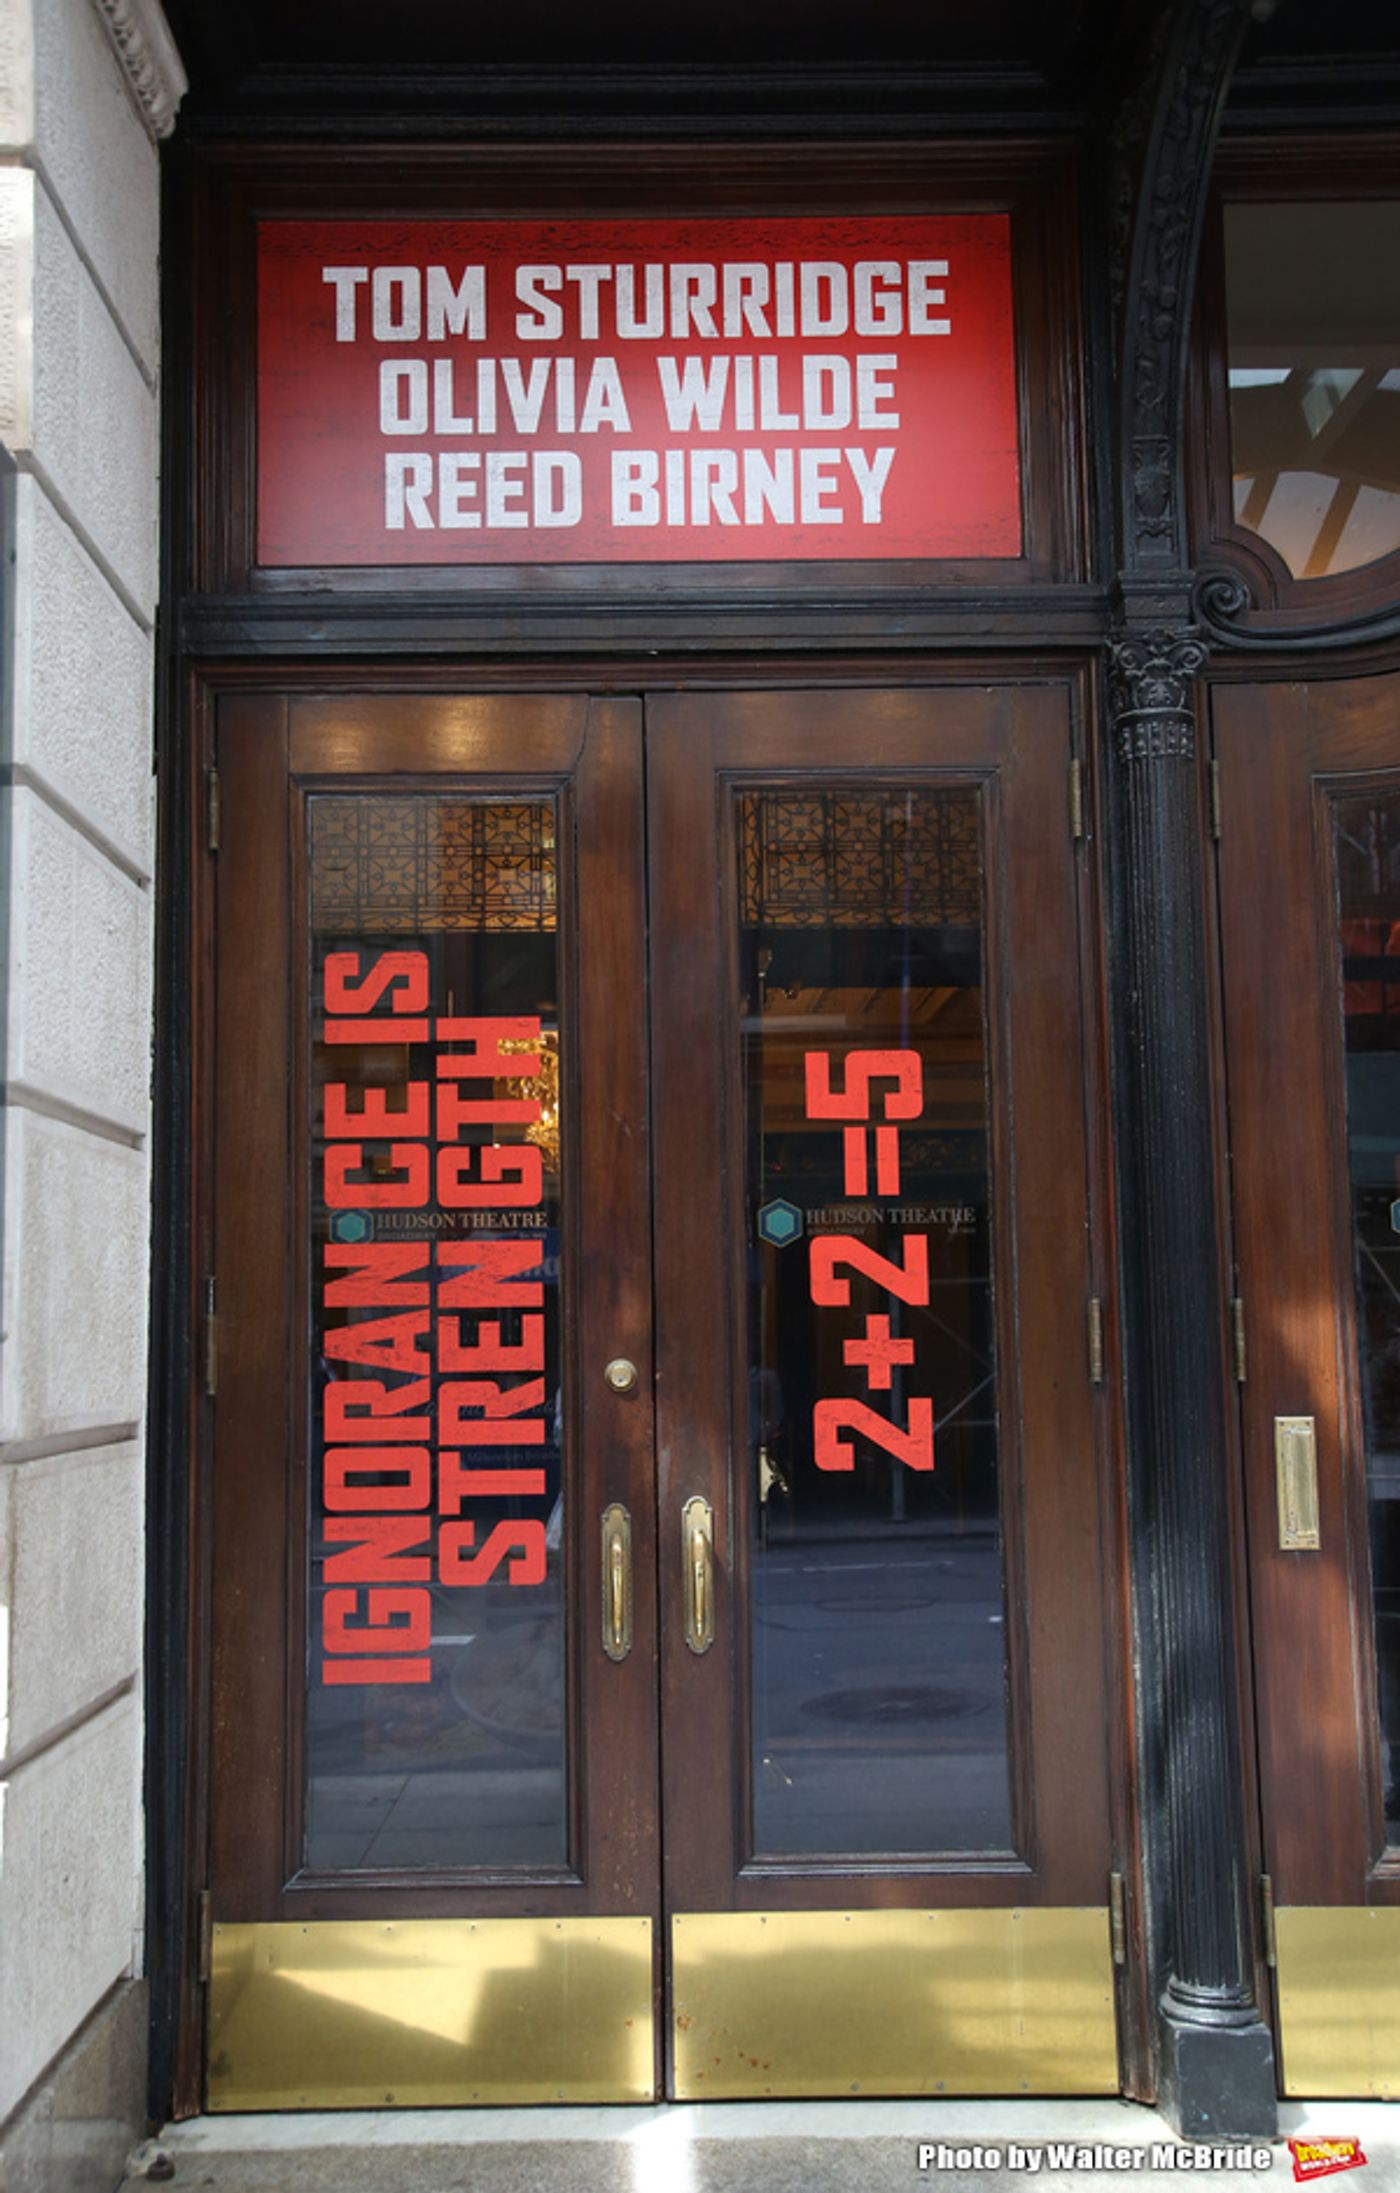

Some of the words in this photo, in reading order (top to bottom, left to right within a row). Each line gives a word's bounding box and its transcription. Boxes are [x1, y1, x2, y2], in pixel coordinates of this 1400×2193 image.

[324, 267, 485, 341] TOM
[517, 262, 950, 339] STURRIDGE
[380, 358, 632, 435] OLIVIA
[657, 355, 899, 432] WILDE
[385, 451, 582, 530] REED
[611, 447, 896, 527] BIRNEY
[325, 952, 428, 1043] IS
[376, 1212, 456, 1229] HUDSON
[459, 1211, 549, 1229] THEATRE
[806, 1208, 884, 1225] HUDSON
[887, 1207, 976, 1224] THEATRE
[437, 1017, 546, 1586] STRENGTH
[805, 1050, 933, 1470] 2+2=5
[323, 1082, 431, 1684] IGNORANCE
